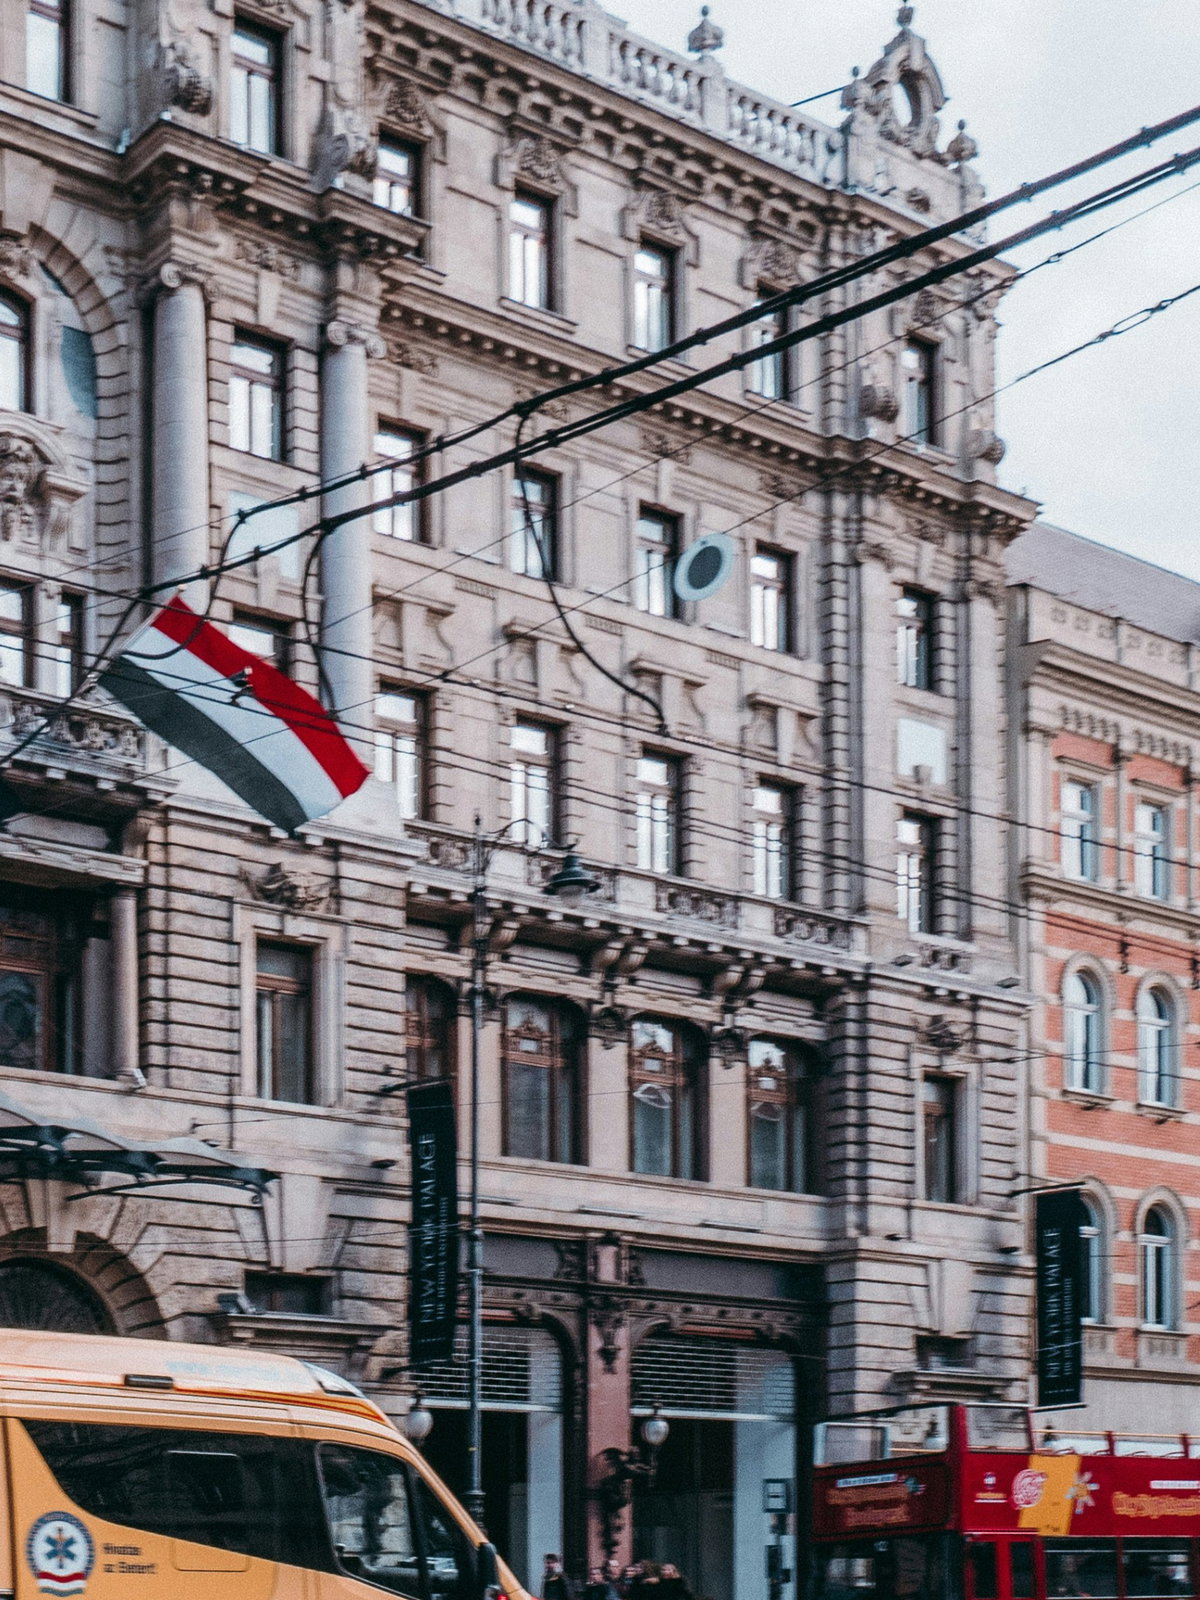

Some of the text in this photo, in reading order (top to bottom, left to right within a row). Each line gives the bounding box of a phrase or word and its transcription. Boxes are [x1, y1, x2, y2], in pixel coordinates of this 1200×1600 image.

[418, 1132, 437, 1323] NEW YORK PALACE
[1043, 1228, 1061, 1287] PALACE
